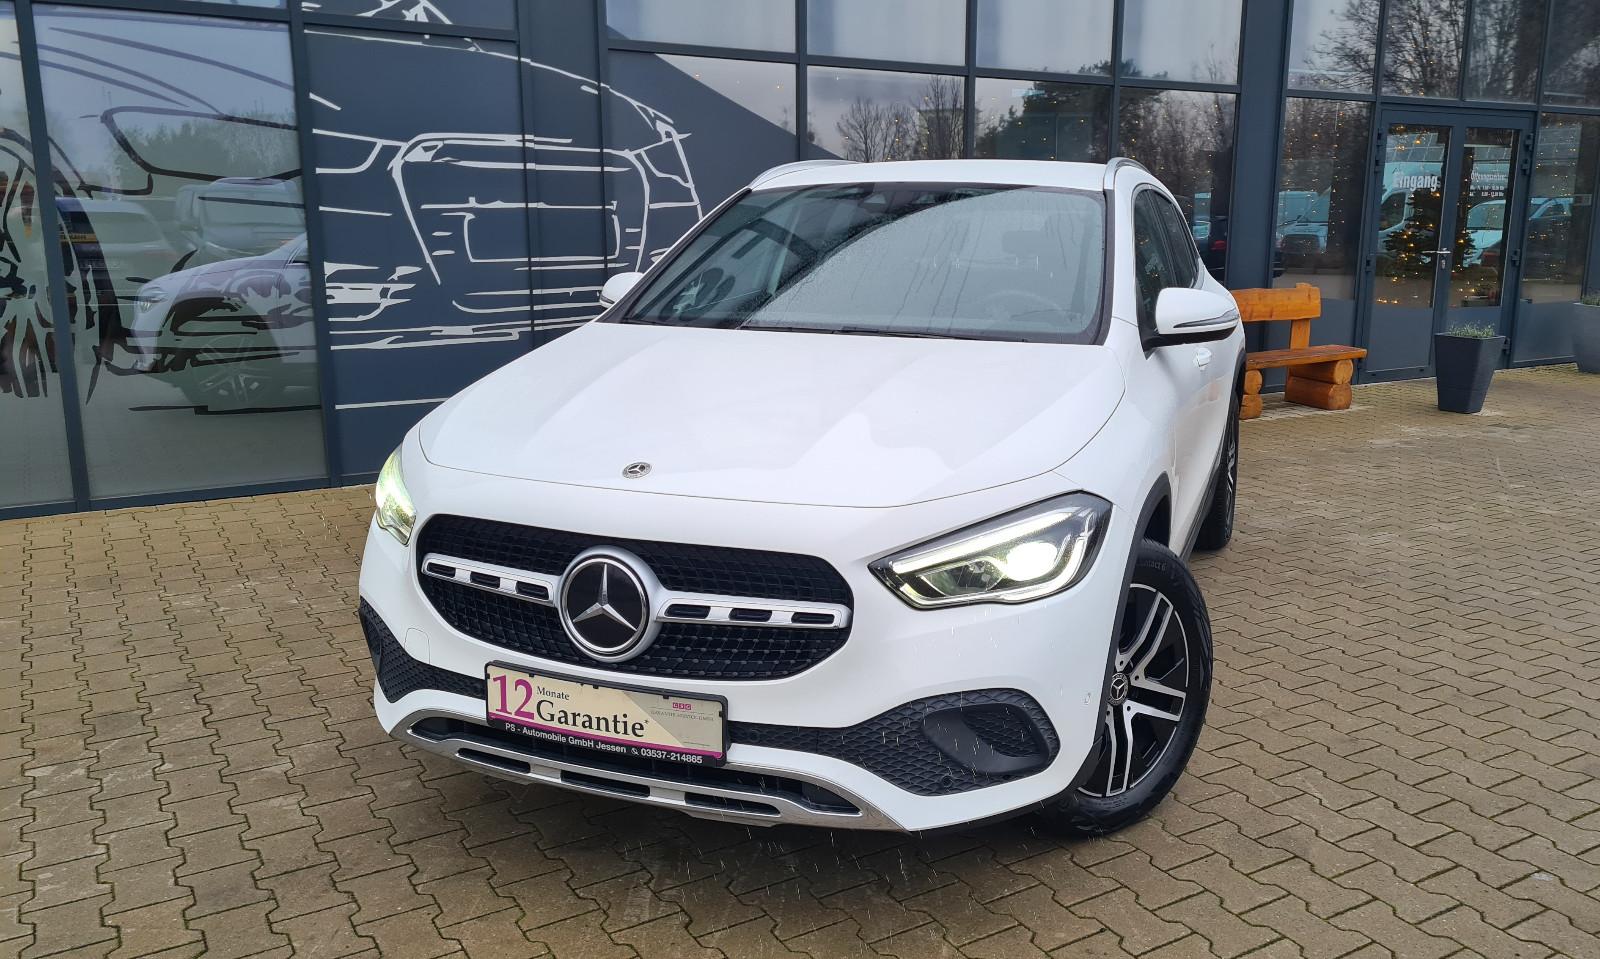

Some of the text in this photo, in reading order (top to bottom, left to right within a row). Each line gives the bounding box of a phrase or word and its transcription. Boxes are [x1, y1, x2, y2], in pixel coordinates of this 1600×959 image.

[492, 674, 535, 720] 12
[537, 686, 571, 701] Monate
[505, 722, 516, 732] PS
[522, 726, 567, 743] Automobile
[568, 736, 594, 749] GmbH
[595, 741, 627, 754] Jessen
